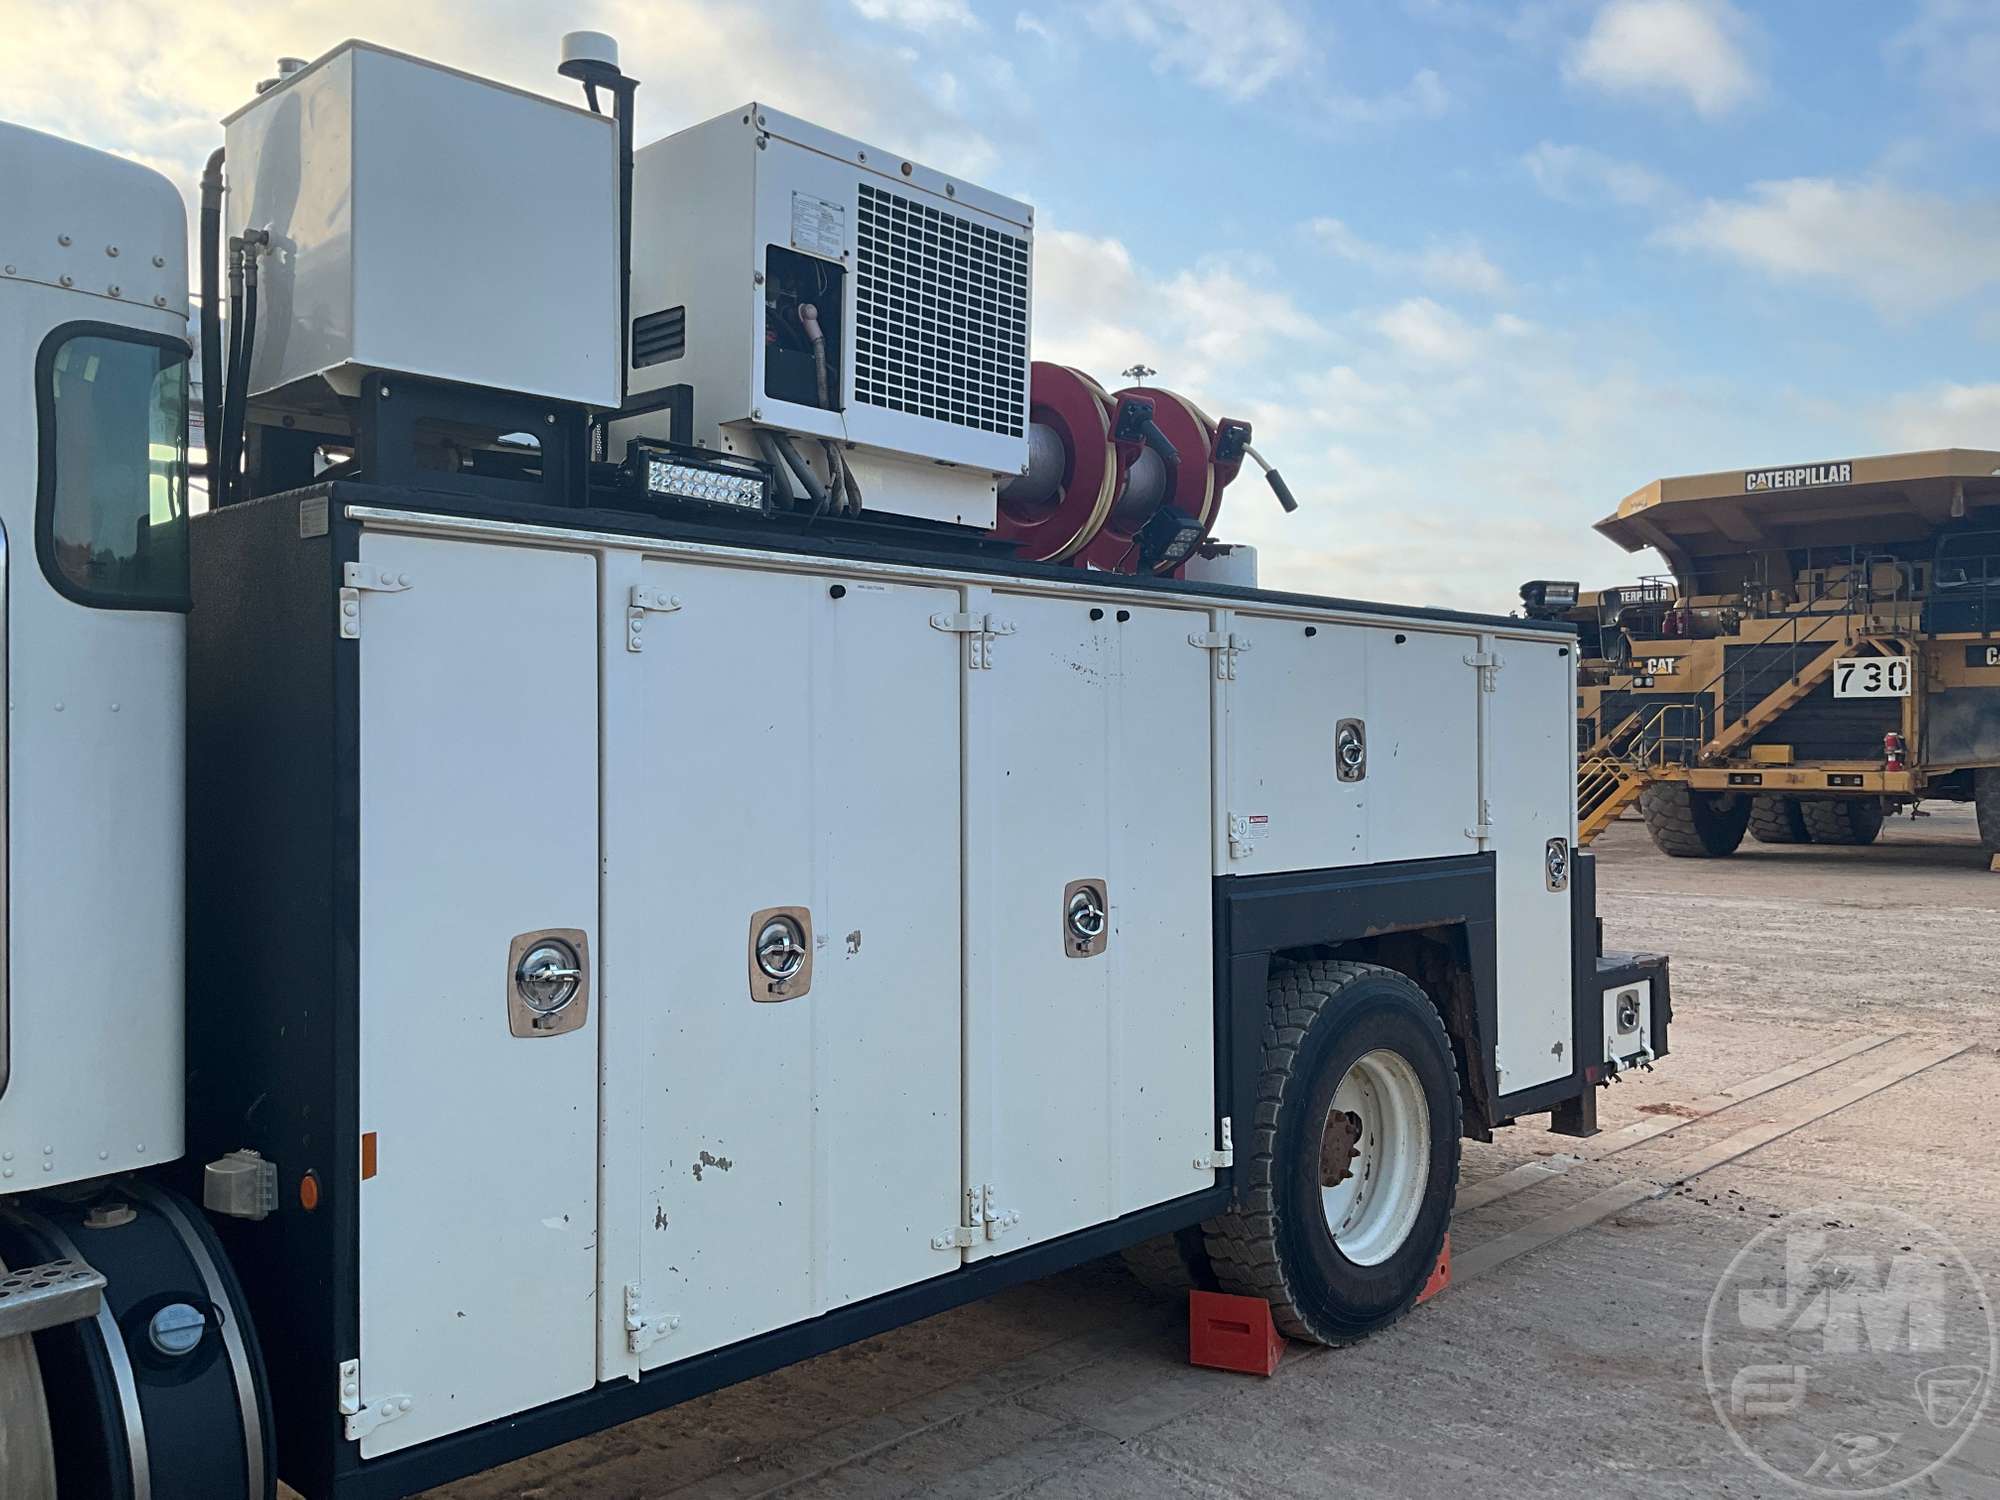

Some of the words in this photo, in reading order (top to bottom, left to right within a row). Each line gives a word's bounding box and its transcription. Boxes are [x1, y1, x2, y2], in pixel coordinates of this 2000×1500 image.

[1747, 464, 1850, 490] CATERPILLAR
[1647, 658, 1674, 675] CAT
[1986, 647, 2000, 665] C
[1837, 661, 1907, 692] 730
